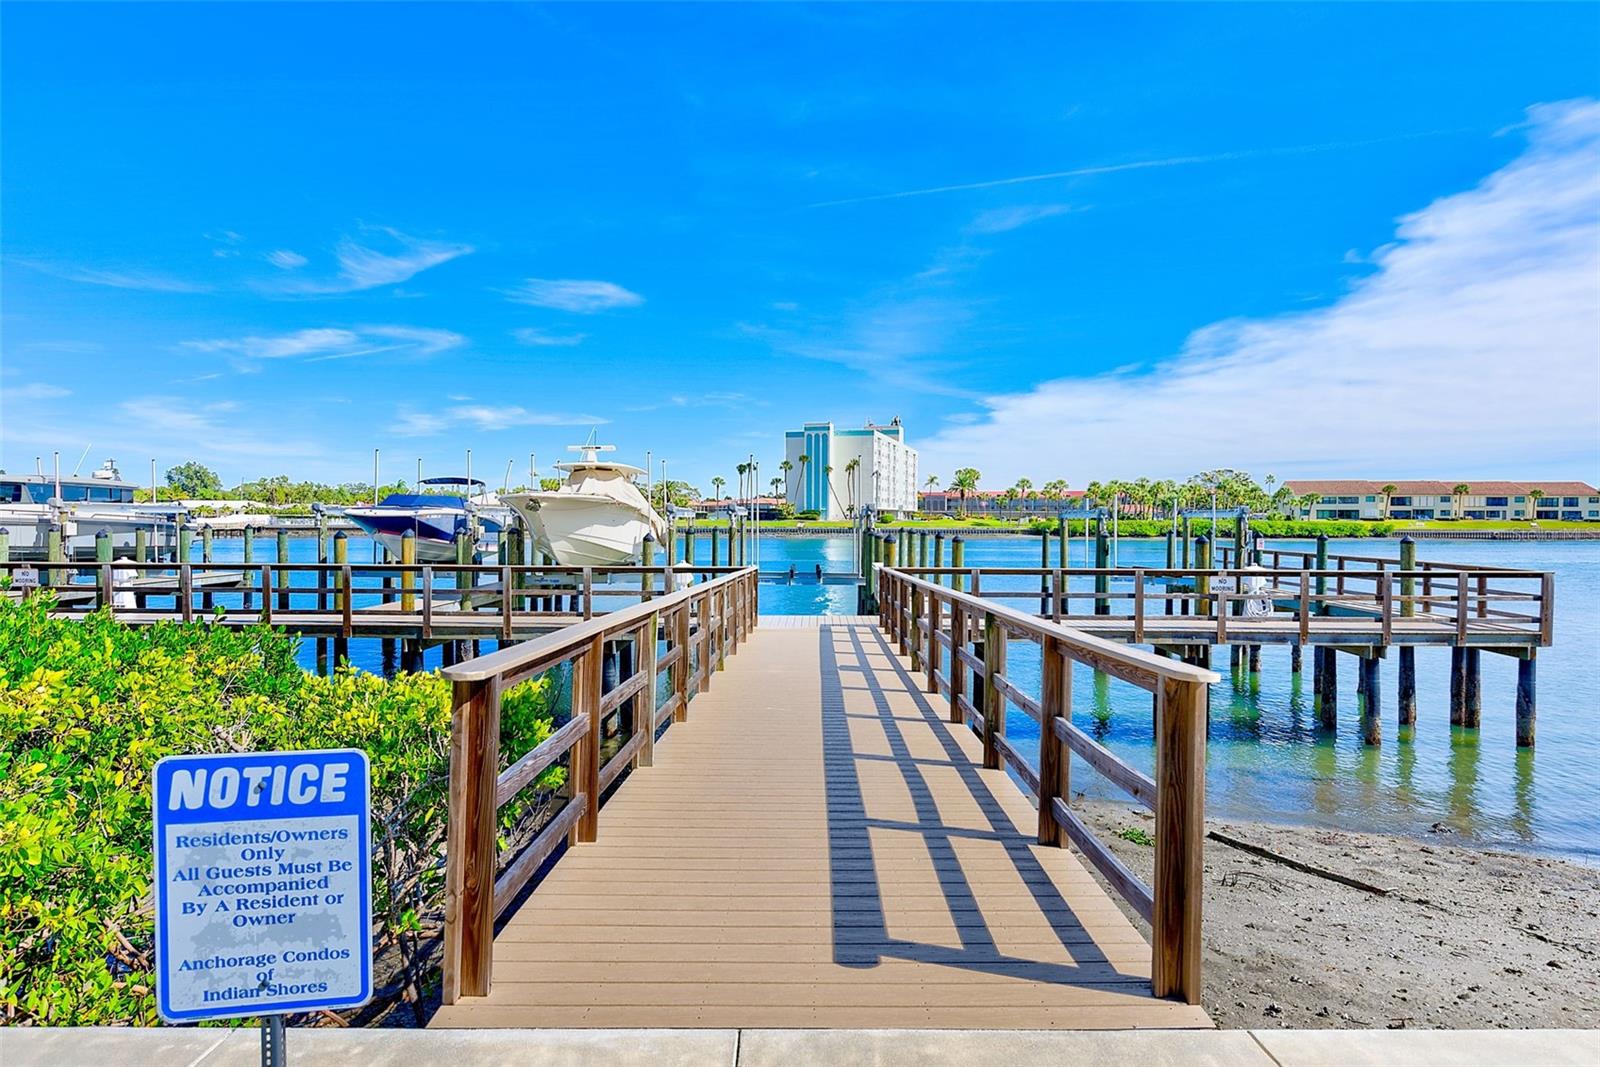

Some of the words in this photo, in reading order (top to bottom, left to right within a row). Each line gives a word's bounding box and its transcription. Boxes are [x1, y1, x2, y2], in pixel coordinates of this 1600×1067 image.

[168, 763, 350, 811] NOTICE
[176, 828, 349, 848] Residents/Owners
[240, 846, 285, 863] Only
[172, 867, 199, 881] All
[206, 864, 272, 880] Guests
[278, 861, 322, 876] Must
[328, 860, 353, 873] Be
[198, 876, 329, 897] Accompanied
[182, 901, 208, 916] By
[215, 900, 230, 912] A
[236, 893, 318, 910] Resident
[325, 892, 345, 905] or
[233, 912, 297, 928] Owner
[178, 953, 277, 972] Anchorage
[282, 948, 350, 963] Condos
[256, 968, 275, 983] of
[203, 987, 260, 1002] Indian
[266, 981, 328, 997] Shores
